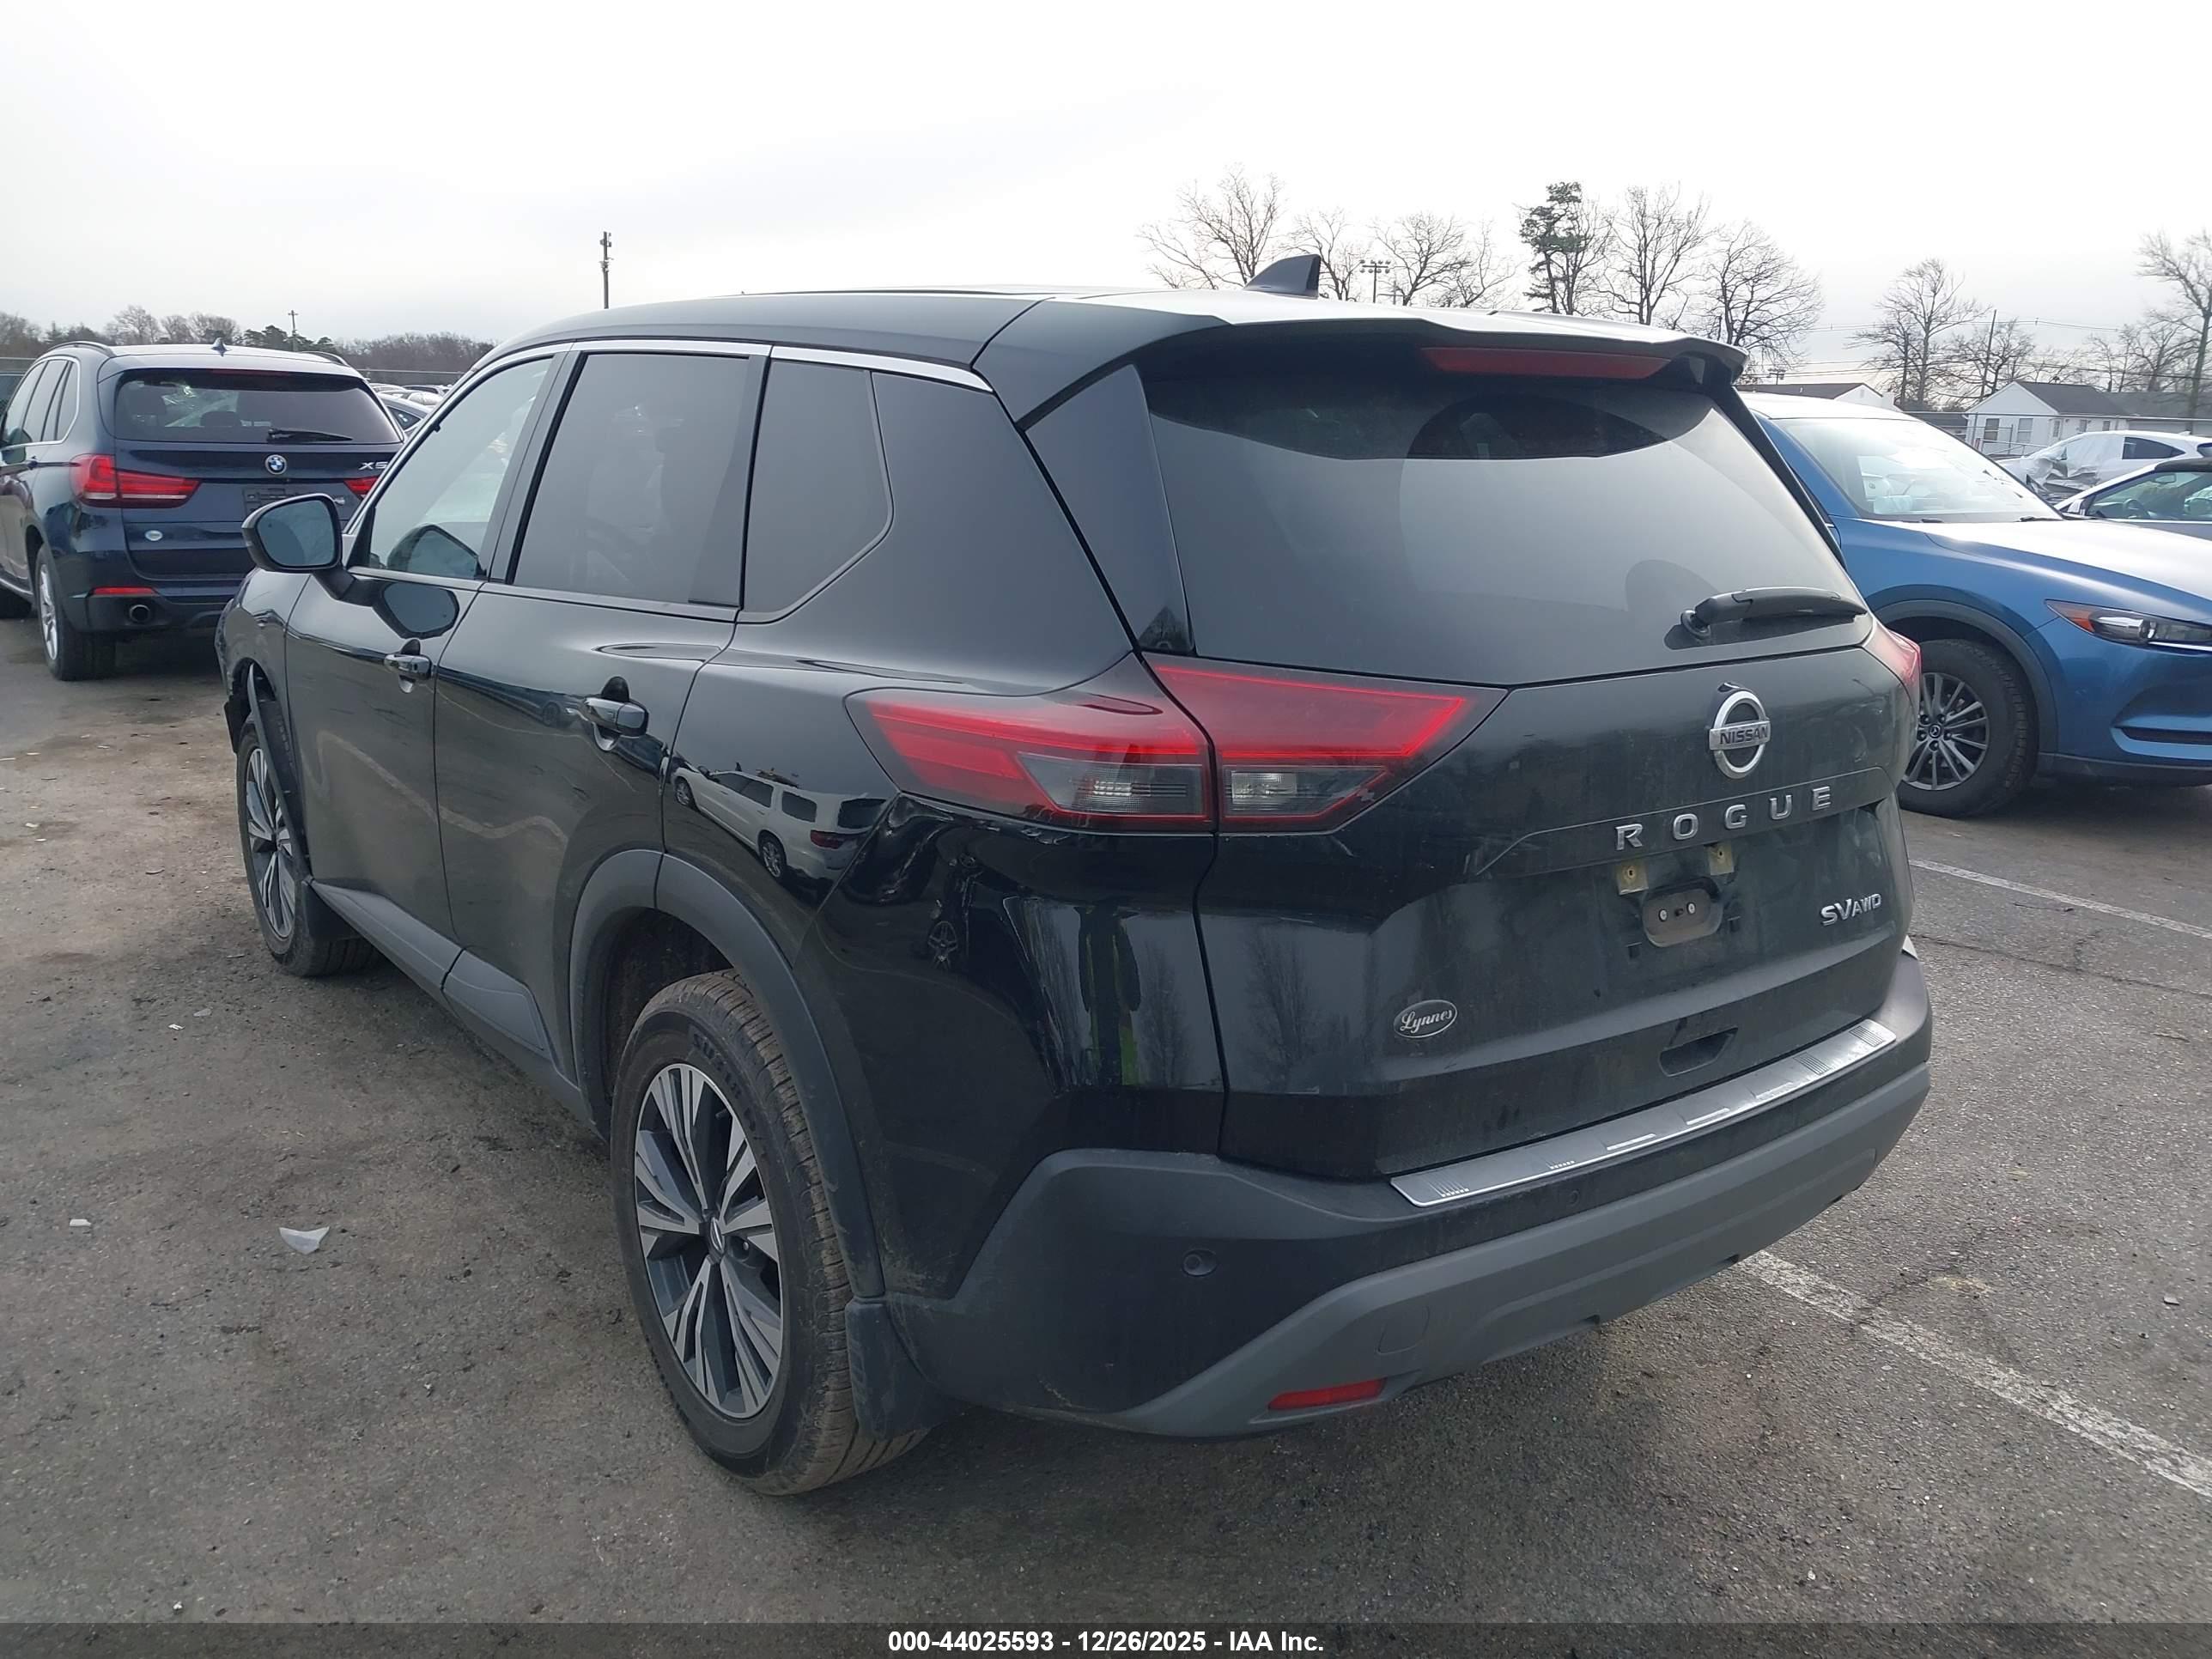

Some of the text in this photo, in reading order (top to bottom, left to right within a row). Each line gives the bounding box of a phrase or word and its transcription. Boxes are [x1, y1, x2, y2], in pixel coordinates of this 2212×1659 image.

[1720, 726, 1768, 745] NISSAN
[1615, 786, 1832, 851] ROGUE
[1400, 1009, 1453, 1034] Lynnes
